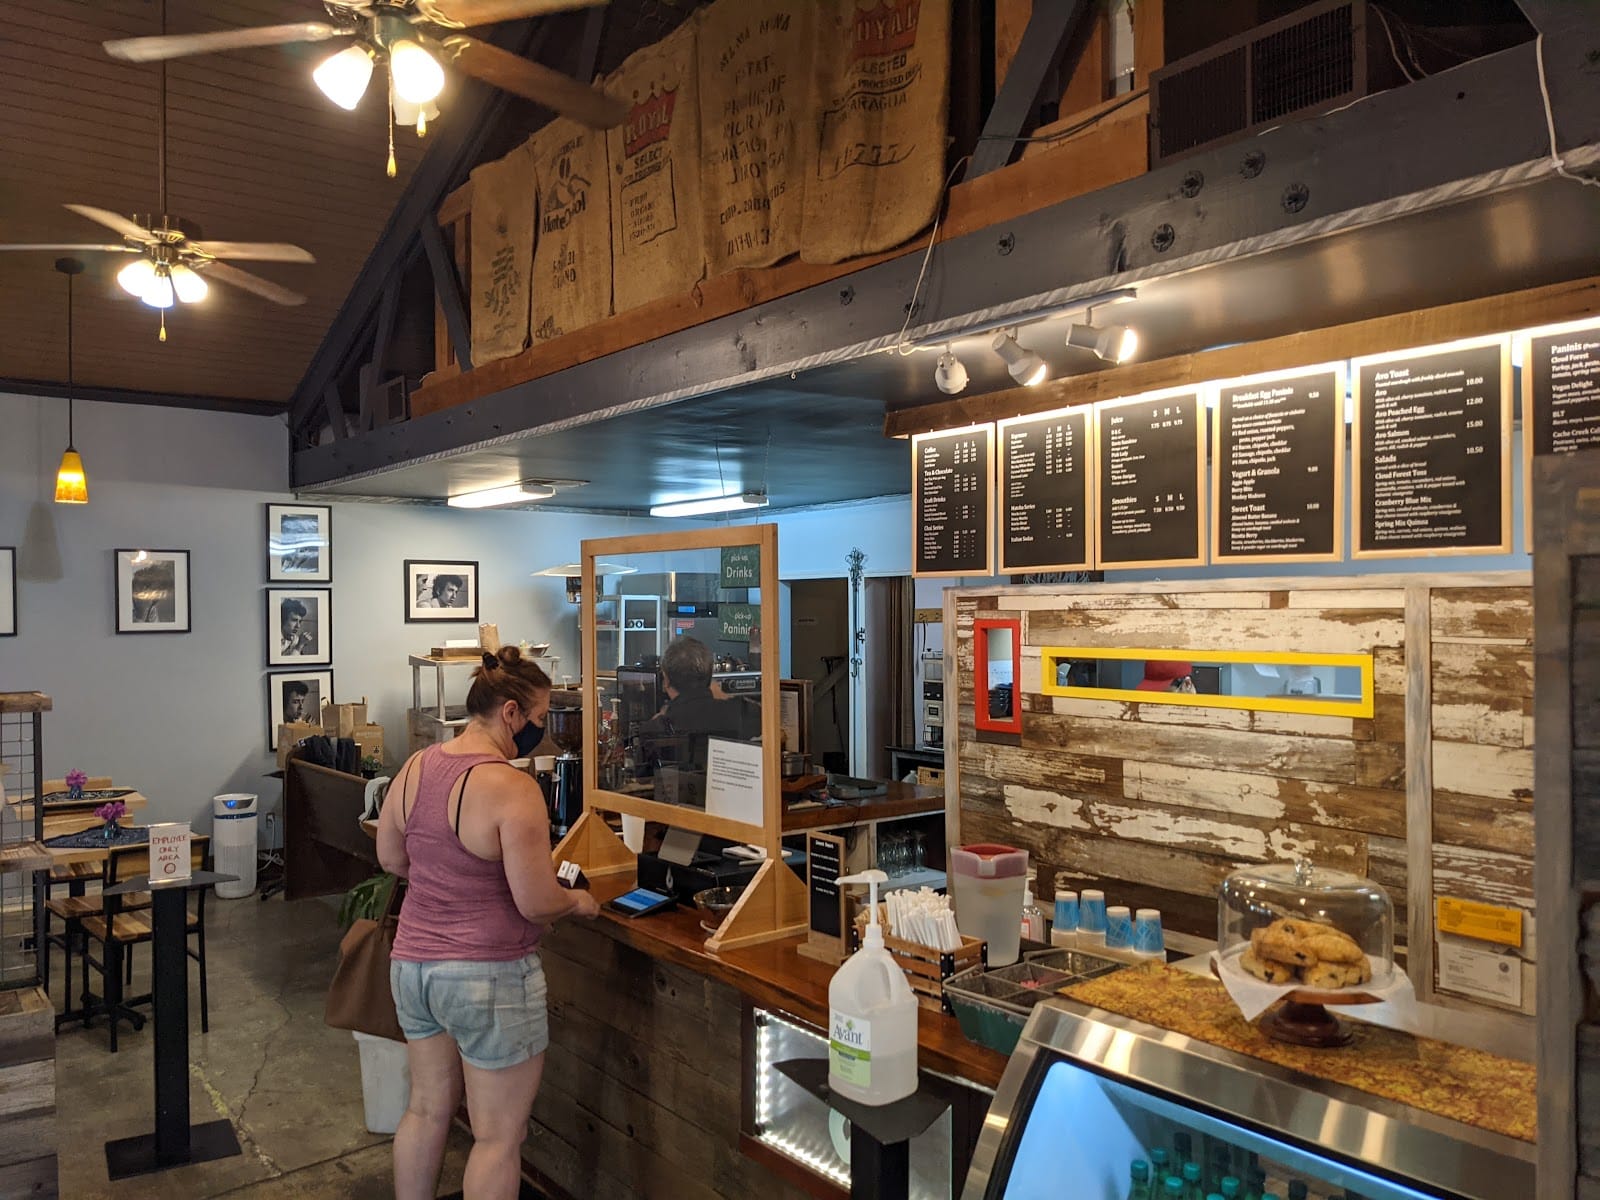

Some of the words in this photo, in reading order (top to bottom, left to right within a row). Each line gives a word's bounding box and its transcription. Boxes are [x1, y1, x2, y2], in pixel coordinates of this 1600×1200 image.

[1552, 343, 1581, 353] Paninis
[1551, 355, 1568, 363] Cloud
[1389, 369, 1409, 378] Toast
[1233, 393, 1259, 402] Breakfast
[1260, 391, 1271, 399] Egg
[1272, 388, 1293, 396] Paninis
[1388, 407, 1412, 416] Poached
[1111, 417, 1123, 425] Juice
[1375, 455, 1396, 463] Salads
[726, 566, 753, 578] Drinks
[734, 612, 752, 621] pick-up
[833, 1023, 863, 1046] Avant
